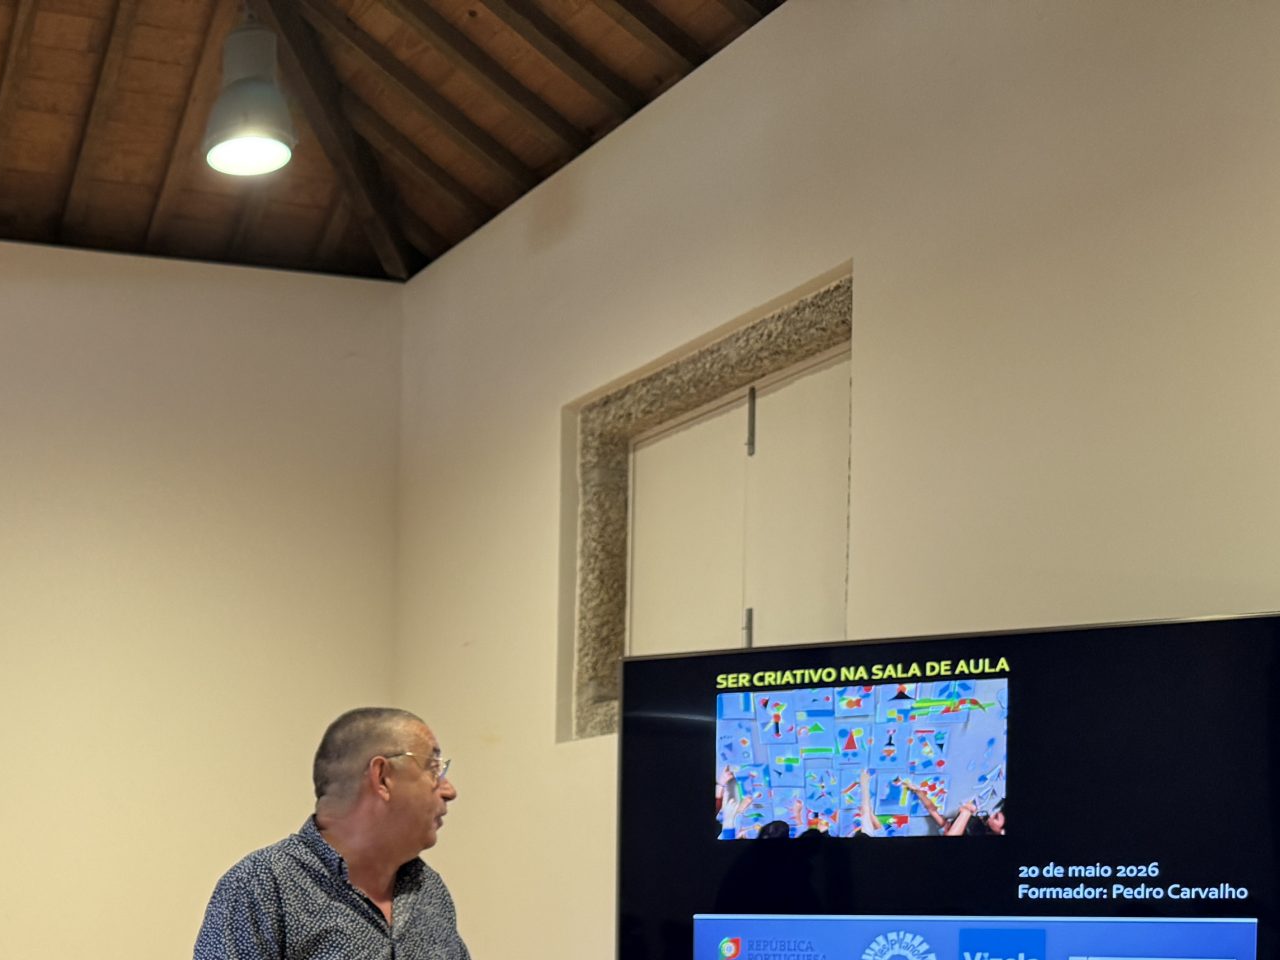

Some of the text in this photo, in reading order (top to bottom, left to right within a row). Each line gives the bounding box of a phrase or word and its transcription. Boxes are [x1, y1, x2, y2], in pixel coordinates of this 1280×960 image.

[716, 657, 1010, 689] SER CRIATIVO NA SALA DE AULA
[1018, 862, 1159, 877] 20 de maio 2026
[1018, 883, 1248, 899] Formador: Pedro Carvalho
[748, 938, 814, 952] REPÚBLICA
